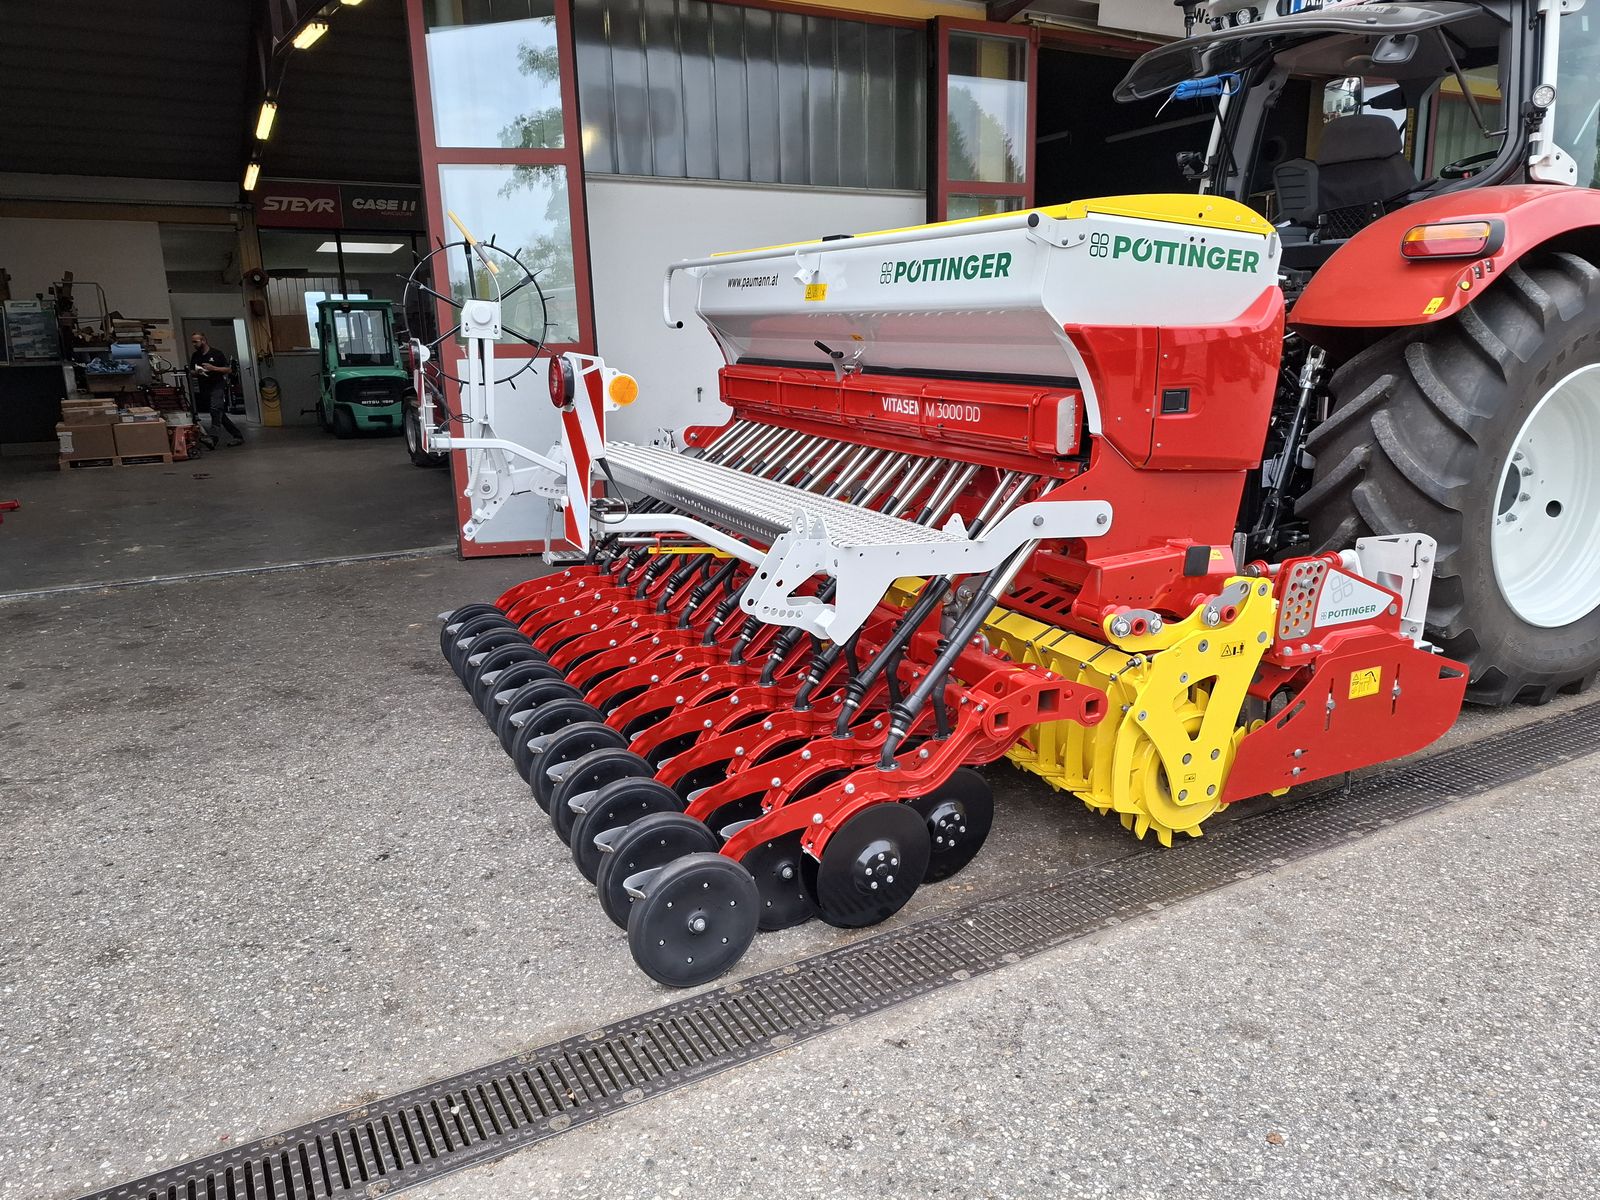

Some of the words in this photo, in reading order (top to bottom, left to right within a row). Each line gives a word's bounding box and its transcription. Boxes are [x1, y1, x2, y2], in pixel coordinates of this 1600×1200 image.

[262, 196, 335, 213] STEYR
[352, 198, 399, 210] CASE
[727, 273, 779, 291] www.paumann.at
[925, 402, 935, 417] M
[936, 402, 963, 420] 3000
[965, 405, 981, 422] DD
